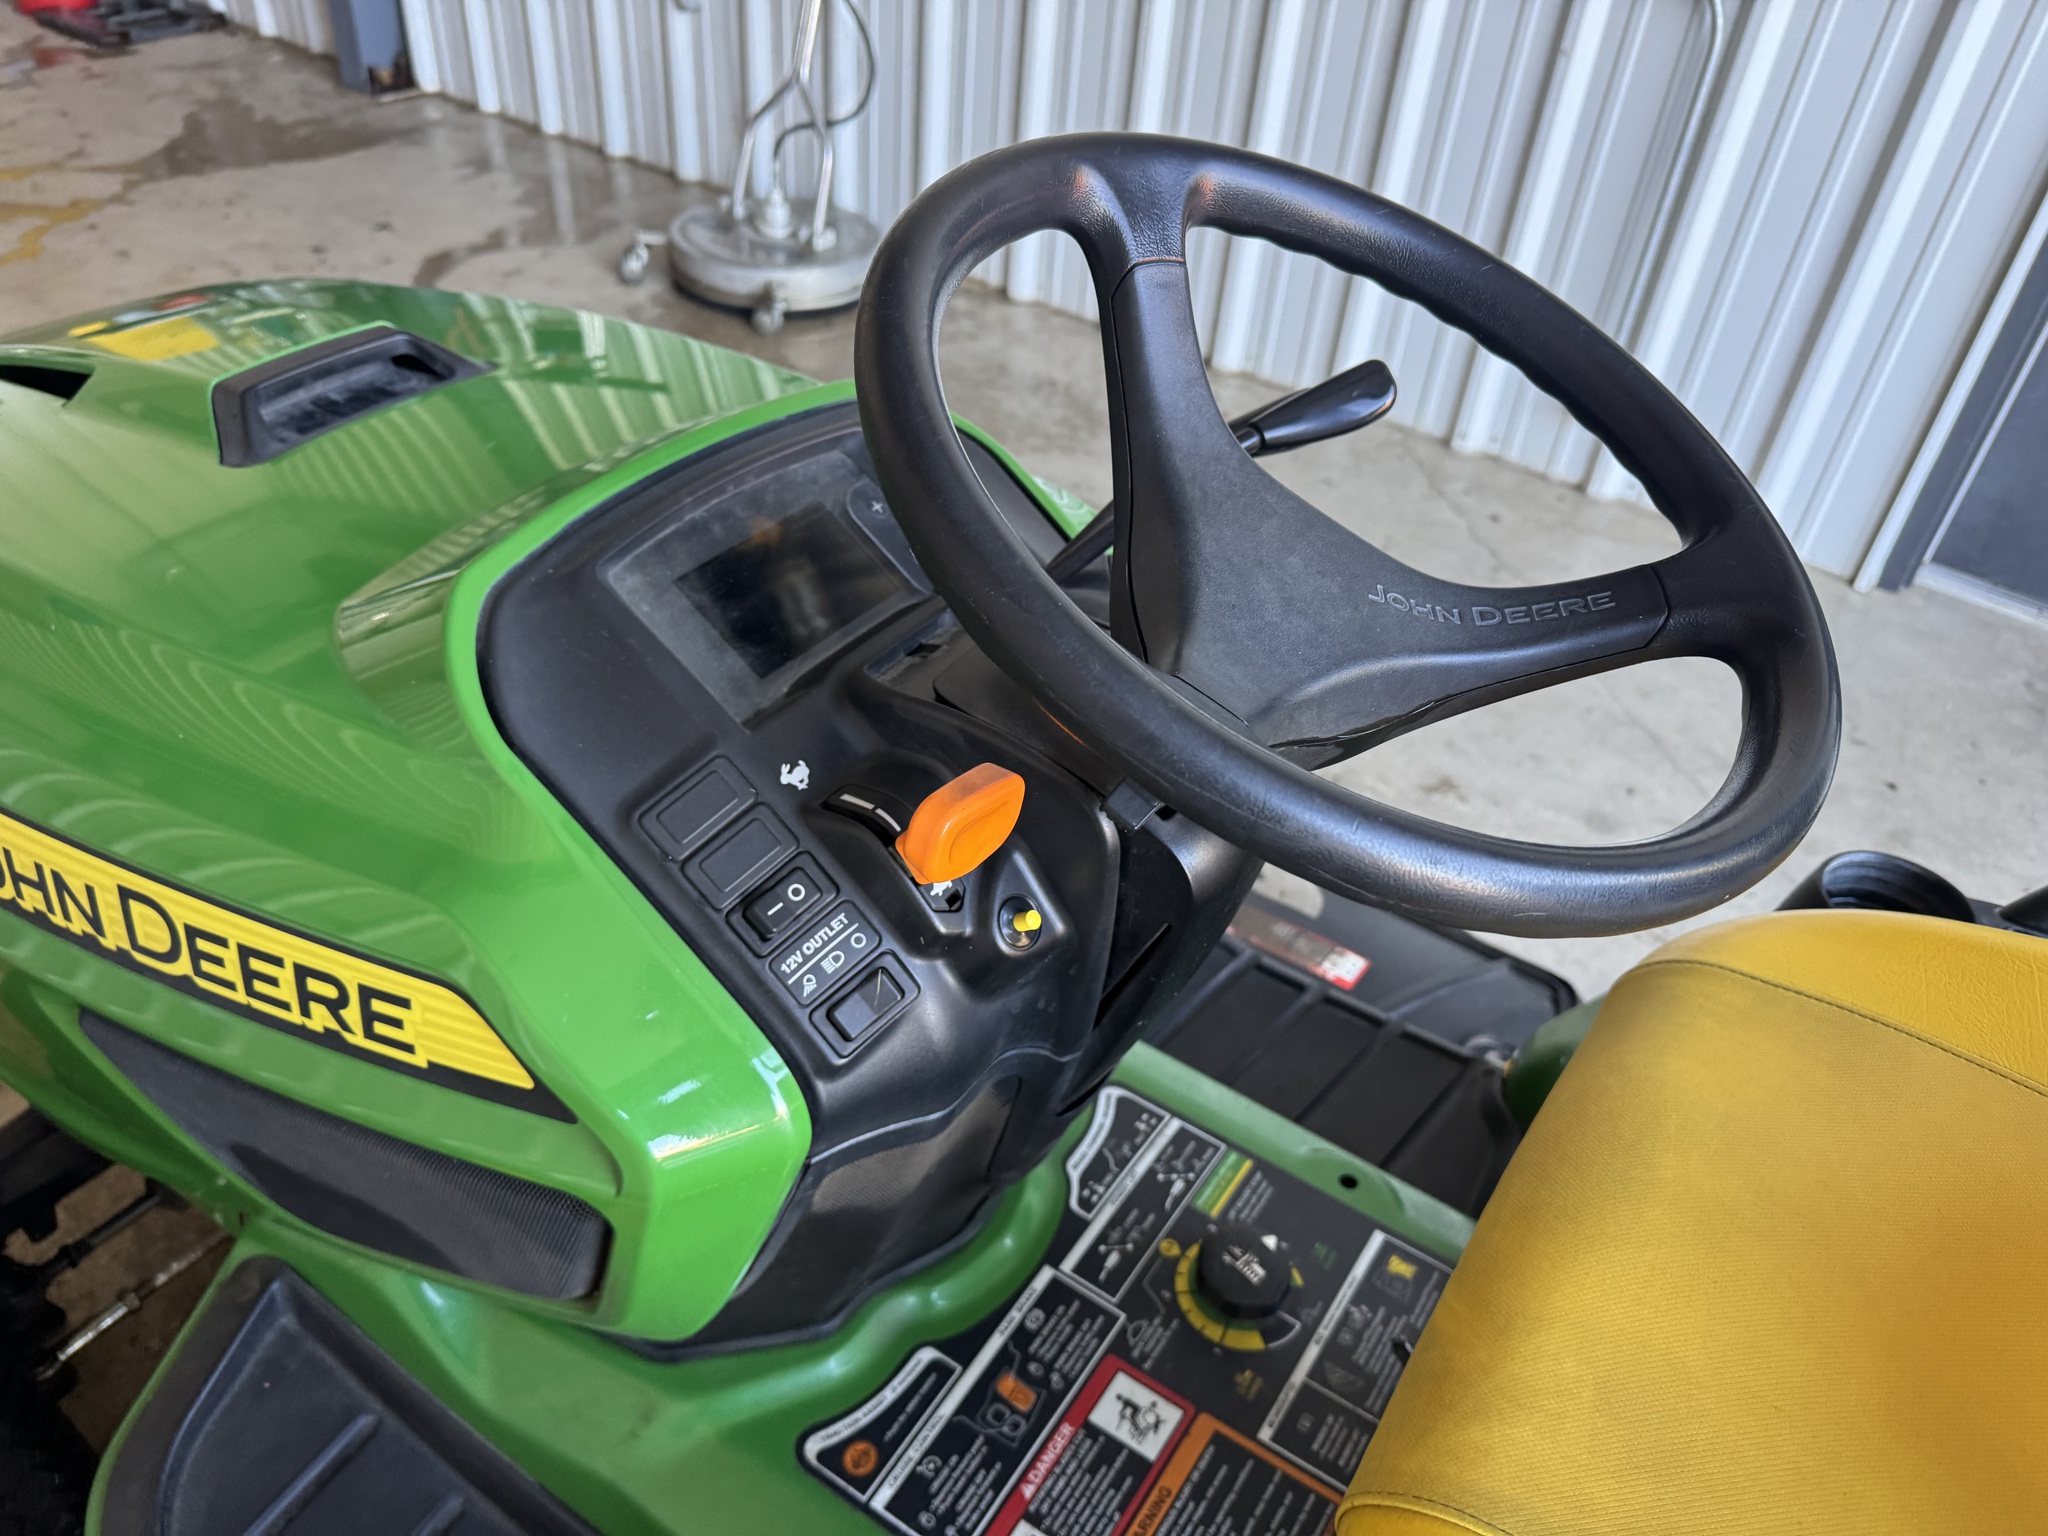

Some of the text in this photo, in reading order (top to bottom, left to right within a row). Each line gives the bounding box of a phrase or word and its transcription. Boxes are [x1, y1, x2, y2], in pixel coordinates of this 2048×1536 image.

[1368, 584, 1616, 627] JOHN DEERE
[0, 846, 416, 1055] HN DEERE
[781, 912, 849, 974] 12V OUTLET
[1026, 1422, 1076, 1482] DANGER
